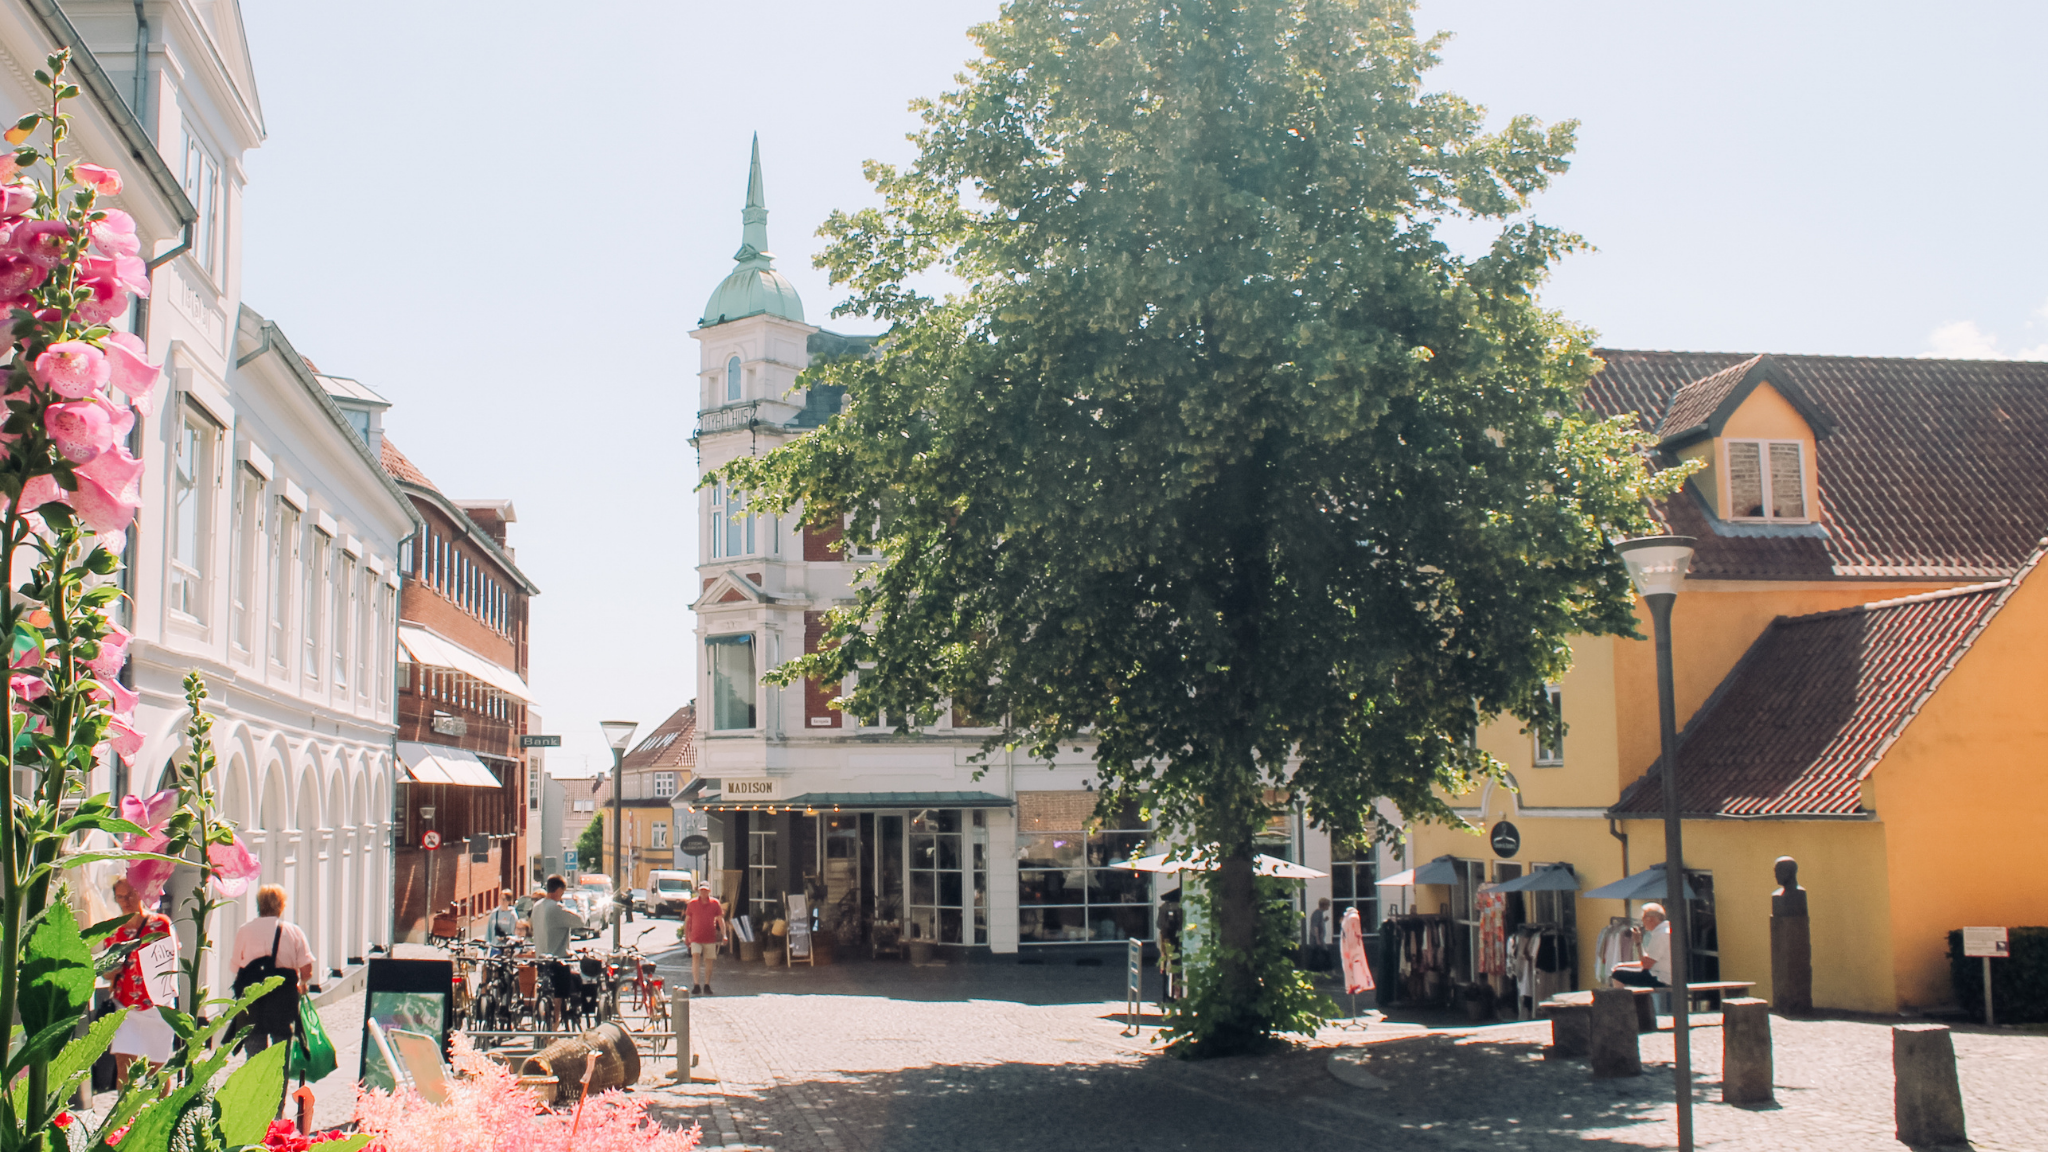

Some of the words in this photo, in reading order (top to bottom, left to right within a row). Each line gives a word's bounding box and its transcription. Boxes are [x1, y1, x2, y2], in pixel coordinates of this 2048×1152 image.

[524, 737, 558, 746] Bank
[728, 782, 773, 794] MADISON
[567, 852, 575, 862] P
